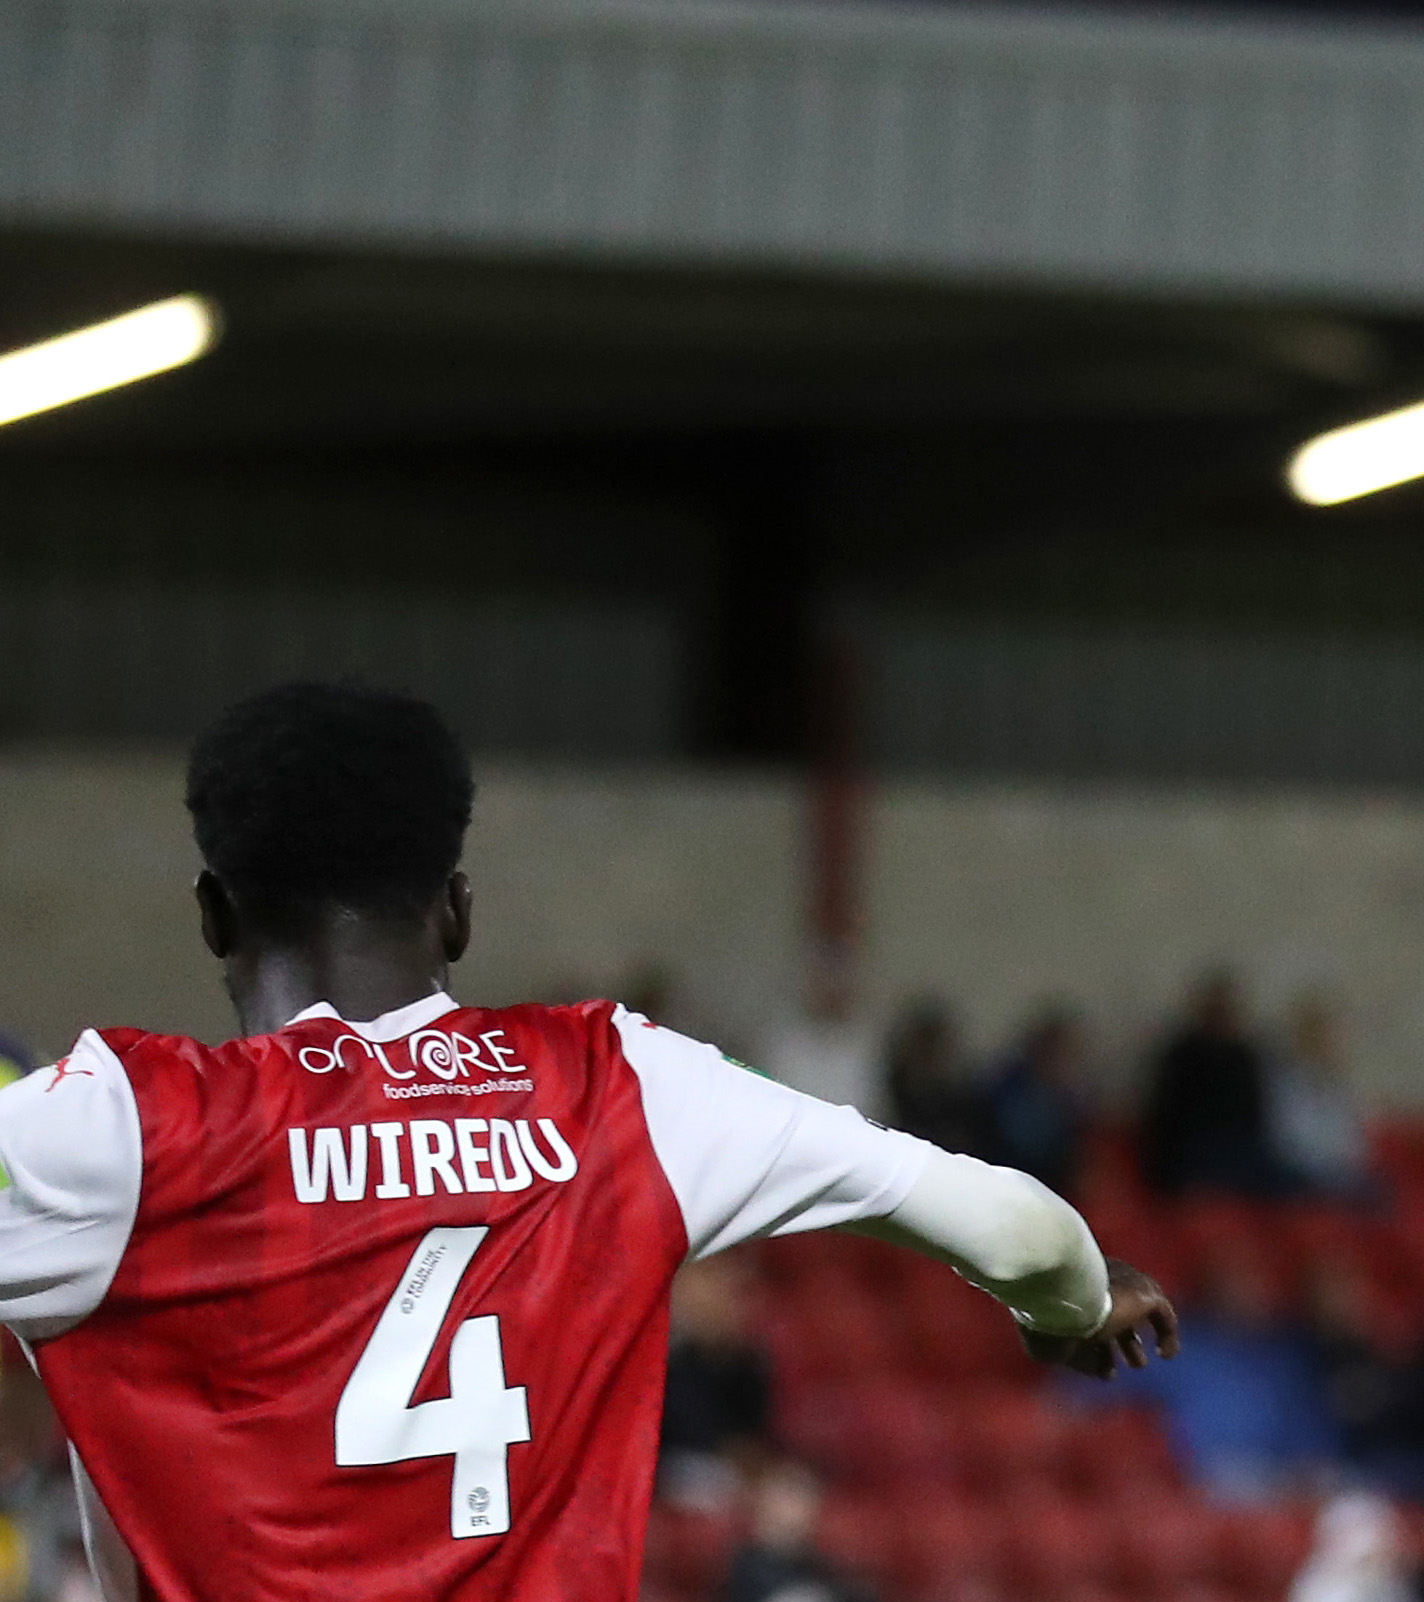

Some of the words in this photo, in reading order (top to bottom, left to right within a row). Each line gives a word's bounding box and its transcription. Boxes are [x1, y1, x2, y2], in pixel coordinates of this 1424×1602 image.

[471, 1077, 535, 1095] solutions
[288, 1118, 578, 1204] WIREDU
[335, 1226, 531, 1539] 4
